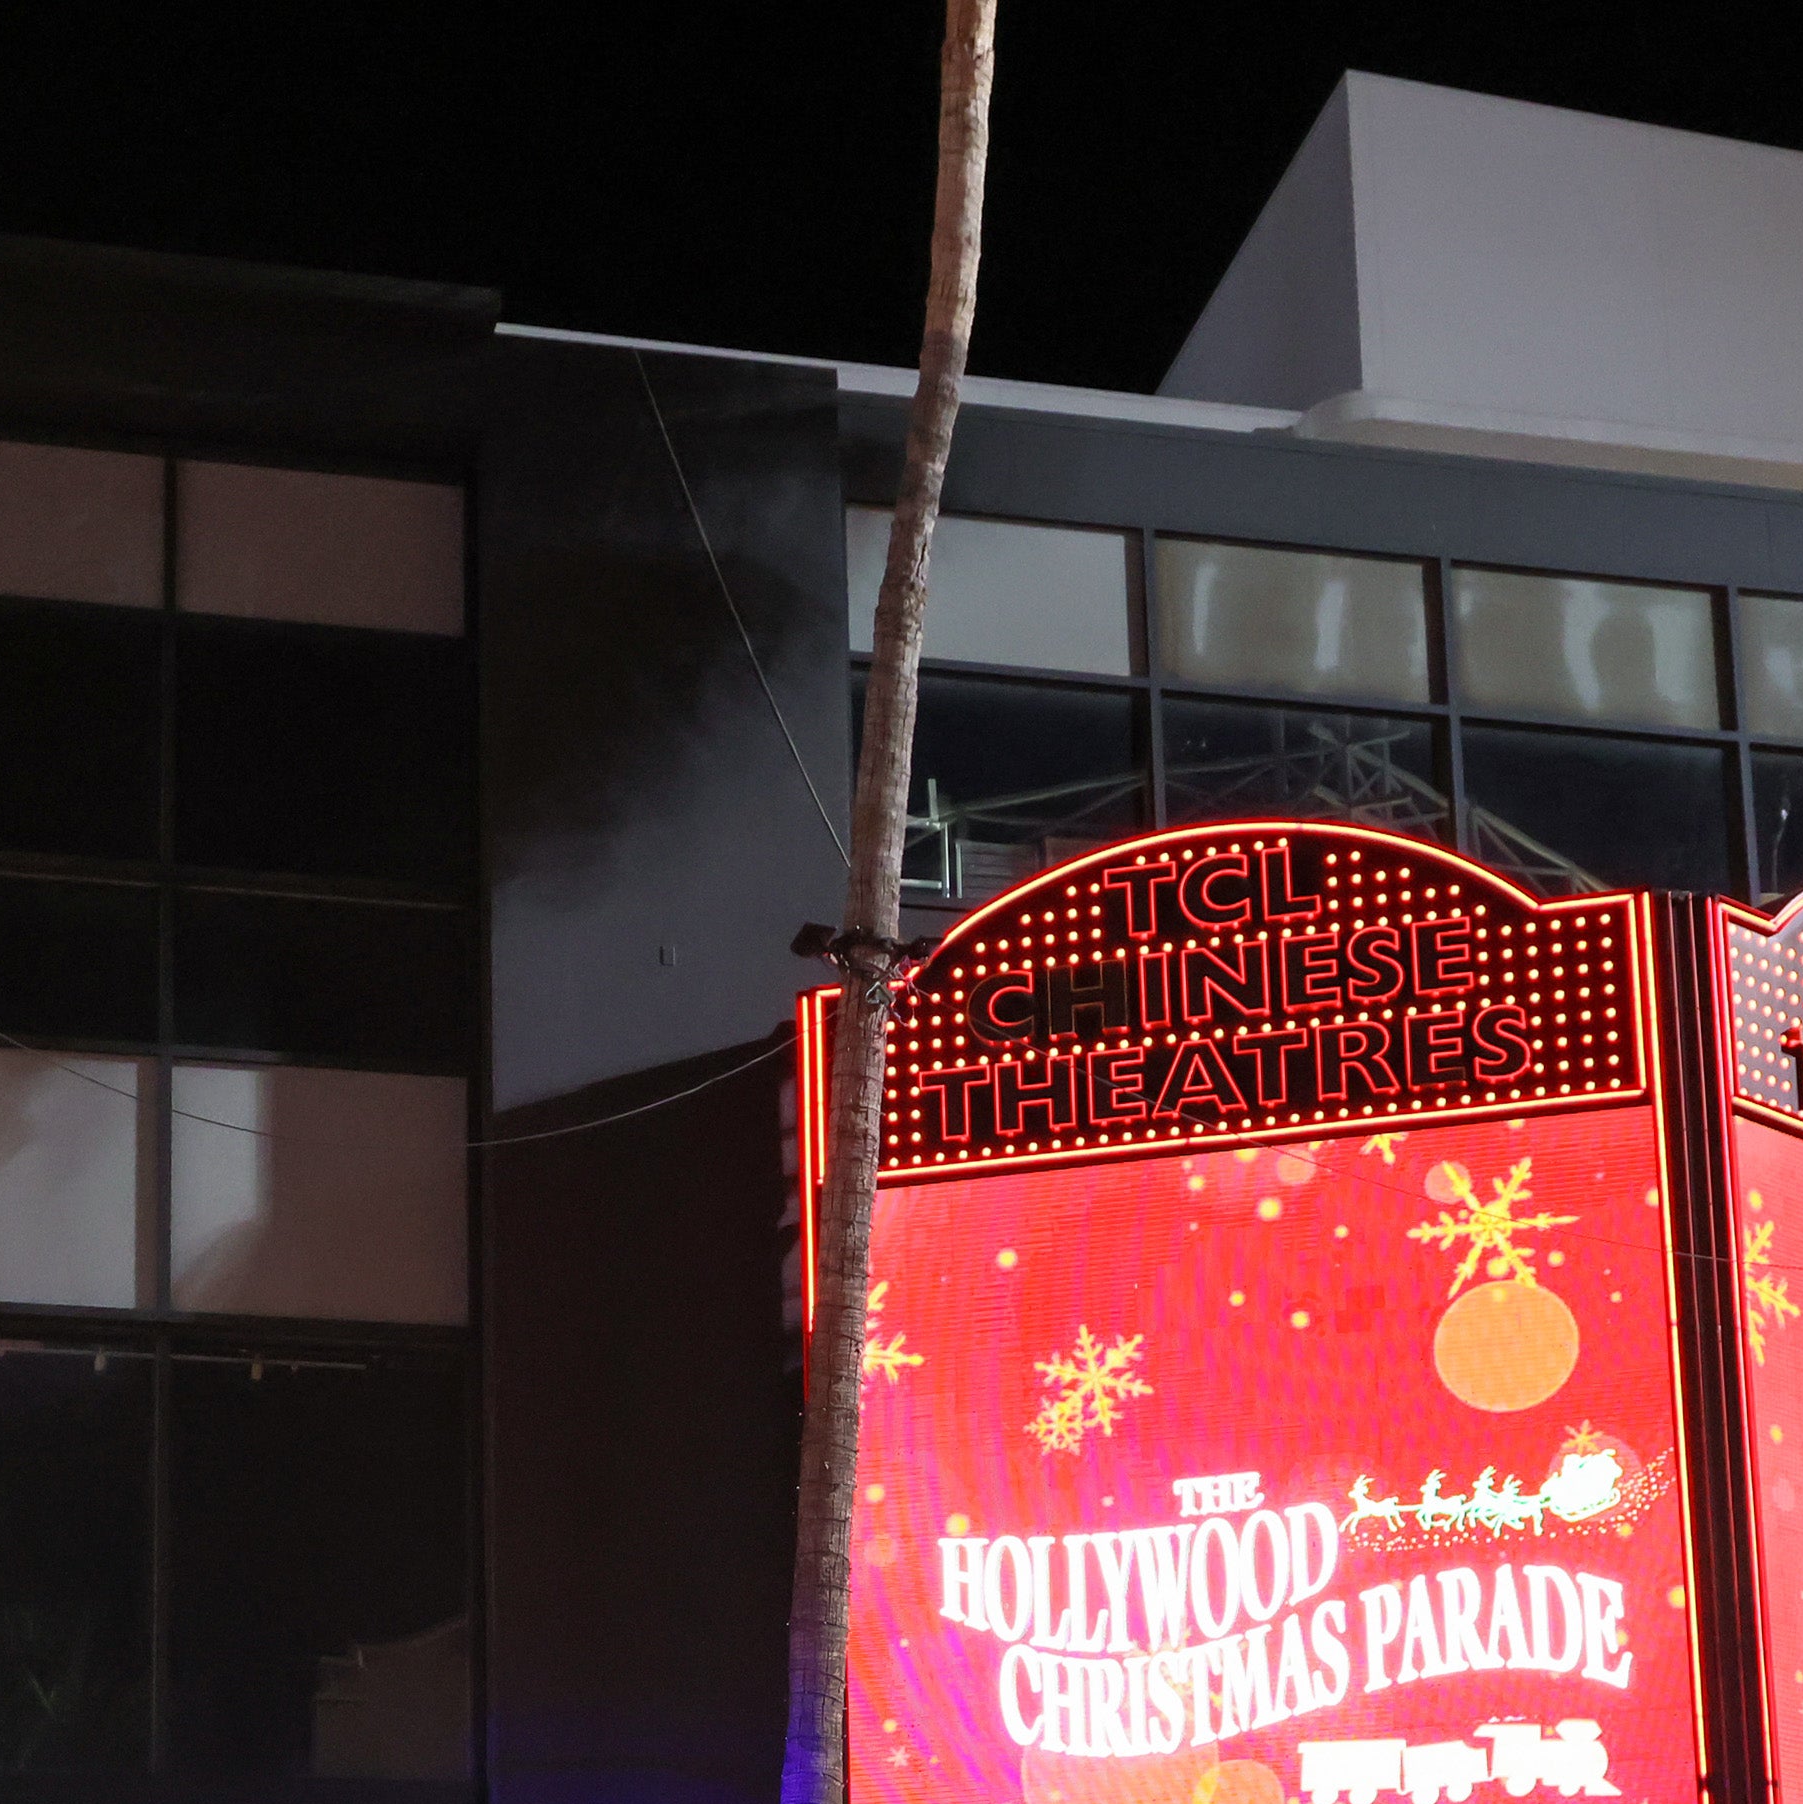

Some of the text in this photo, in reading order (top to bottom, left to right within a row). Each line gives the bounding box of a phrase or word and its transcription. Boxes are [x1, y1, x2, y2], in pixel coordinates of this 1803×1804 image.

[1103, 846, 1322, 942] TCL
[965, 916, 1477, 1043] CHINESE
[918, 1004, 1532, 1142] THEATRES
[1173, 1471, 1265, 1518] THE
[937, 1501, 1341, 1655] HOLLYWOOD
[998, 1563, 1633, 1758] CHRISTMAS PARADE
